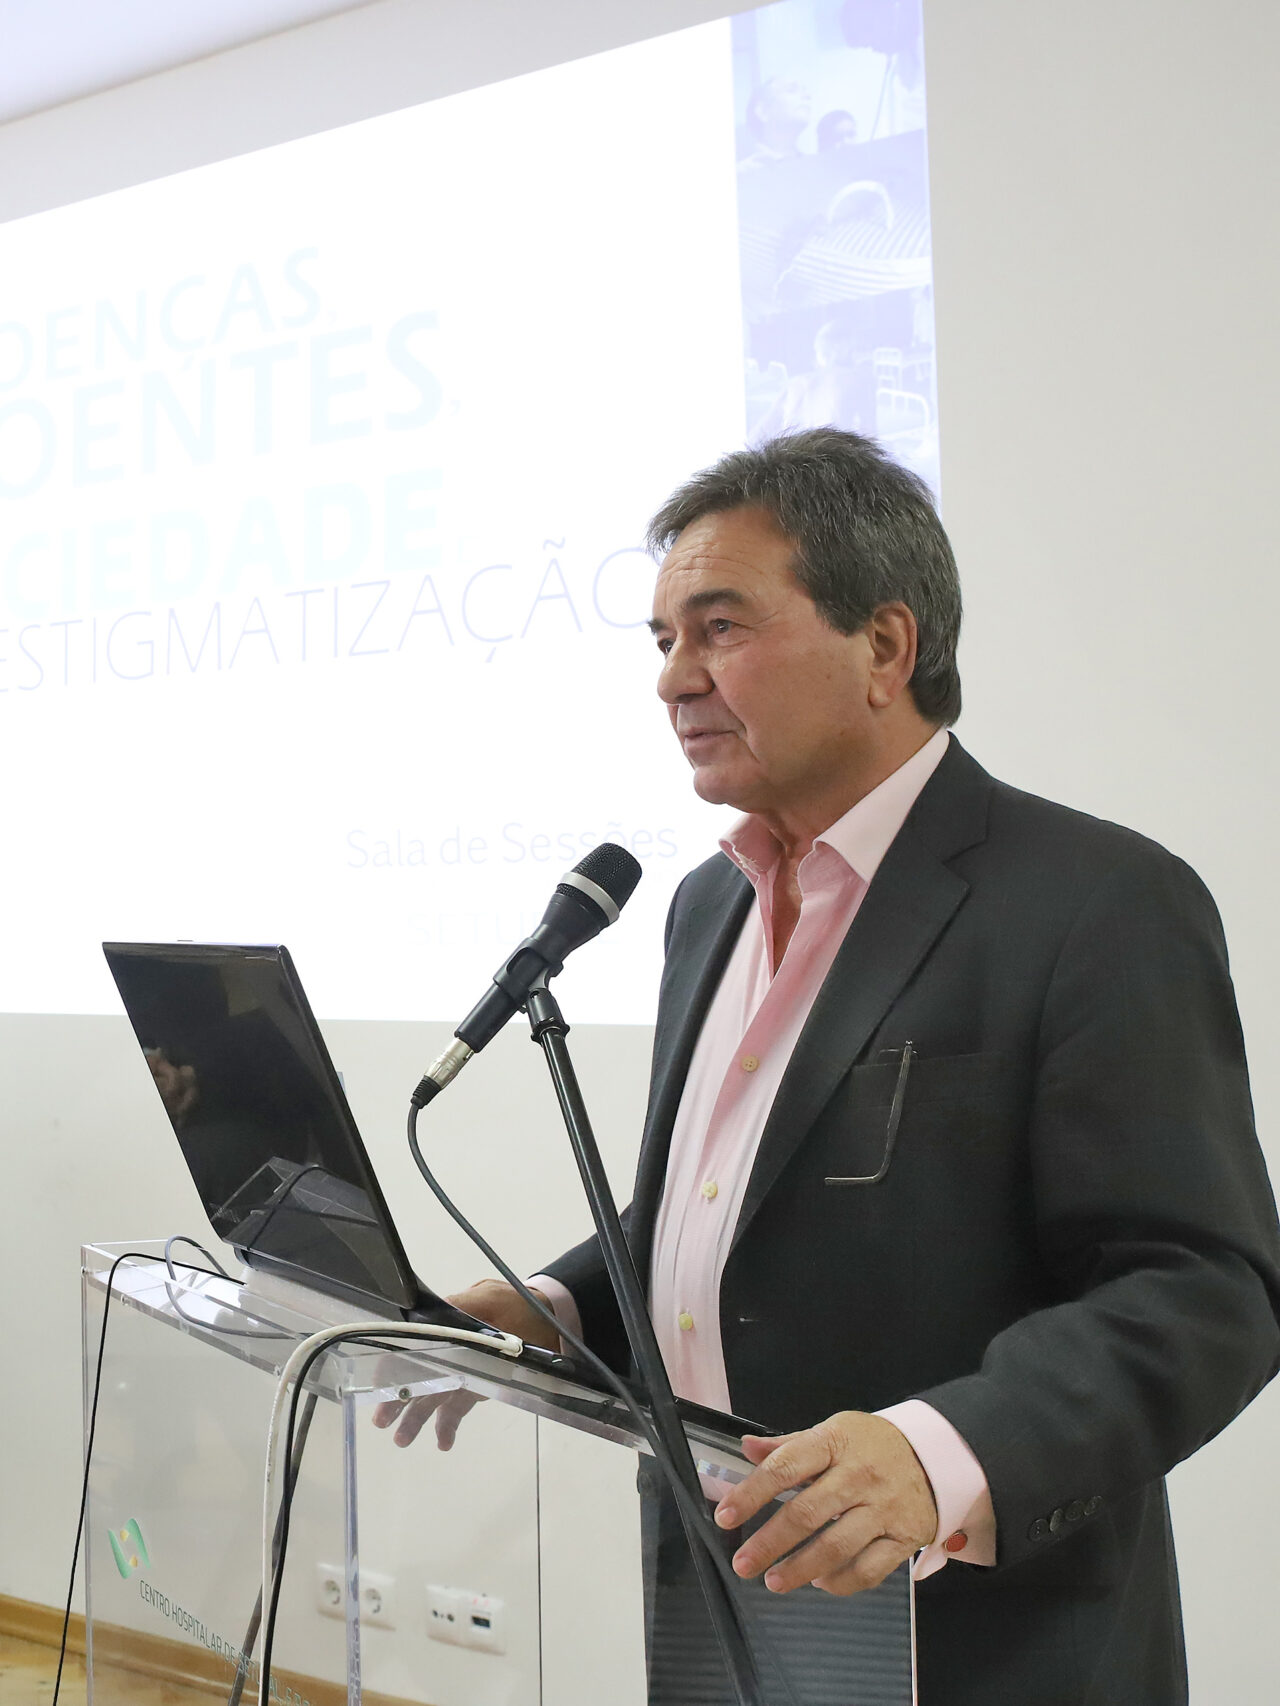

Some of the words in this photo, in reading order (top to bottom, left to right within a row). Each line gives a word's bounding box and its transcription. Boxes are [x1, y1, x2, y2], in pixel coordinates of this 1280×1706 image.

[346, 829, 427, 868] Sala
[439, 825, 488, 864] de
[139, 1579, 170, 1617] CENTRO
[171, 1603, 222, 1655] HOSPITALAR
[224, 1641, 237, 1668] DE
